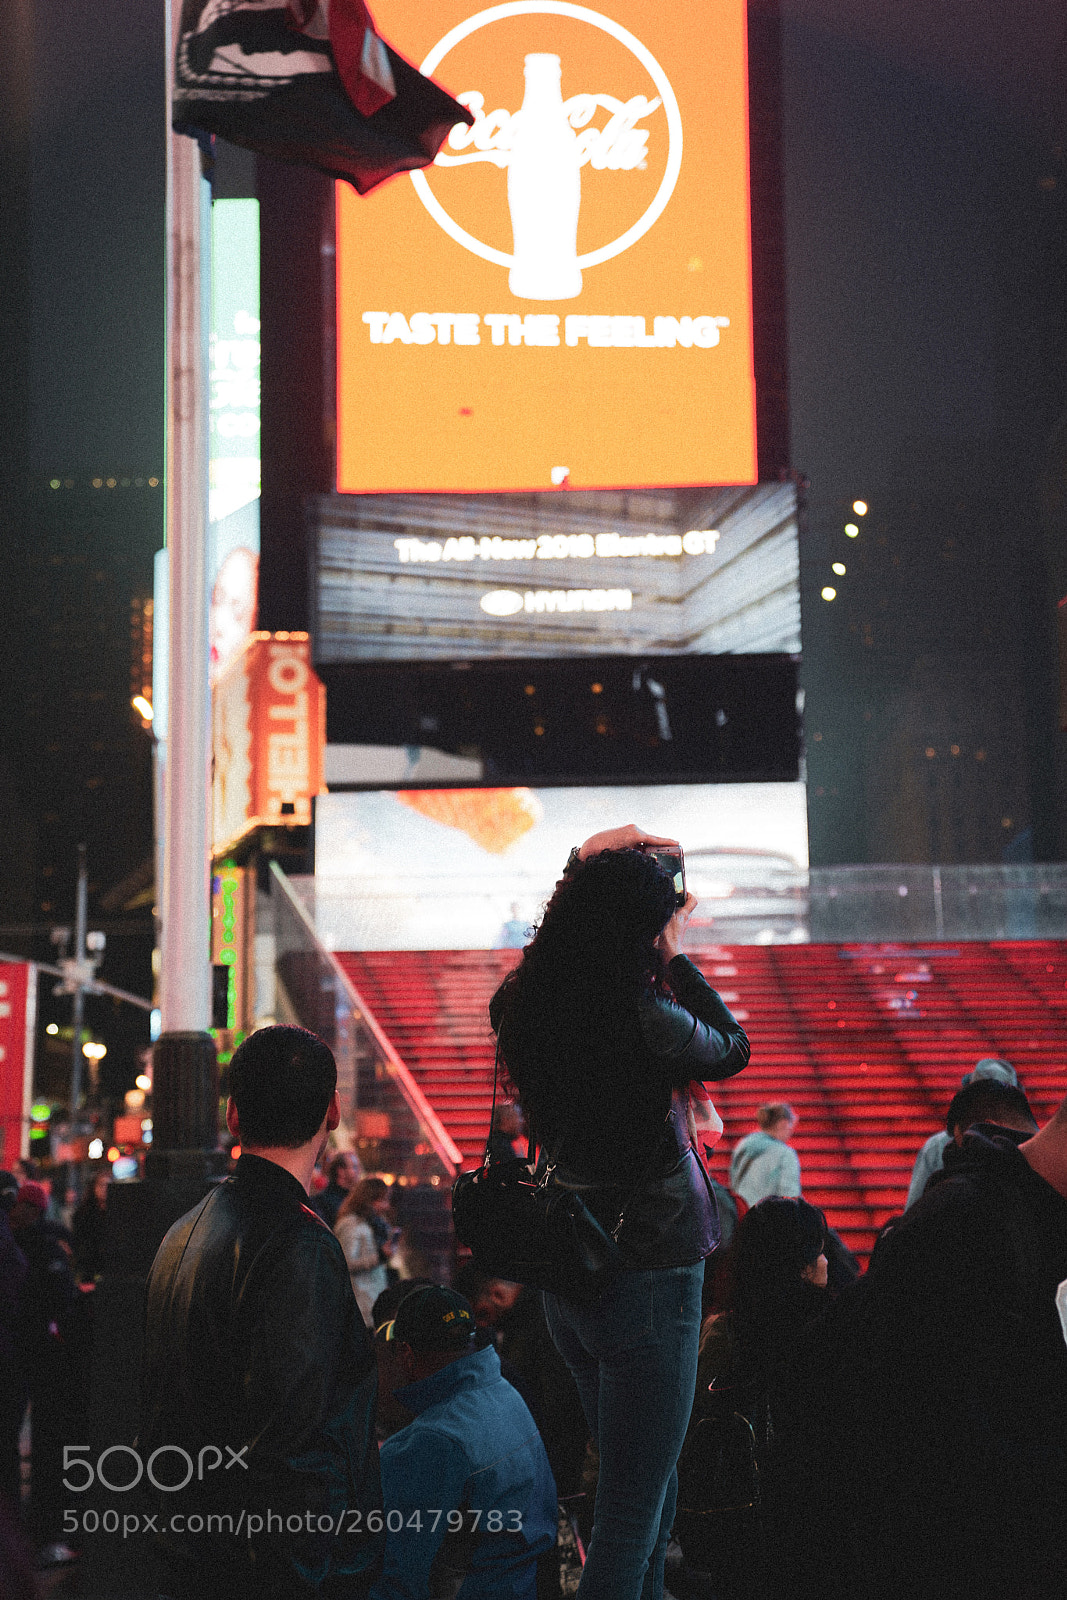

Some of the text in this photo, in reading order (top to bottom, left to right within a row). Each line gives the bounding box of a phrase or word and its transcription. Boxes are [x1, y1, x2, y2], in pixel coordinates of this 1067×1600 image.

[362, 311, 480, 345] TASTE
[484, 313, 560, 346] THE
[394, 538, 442, 562] The
